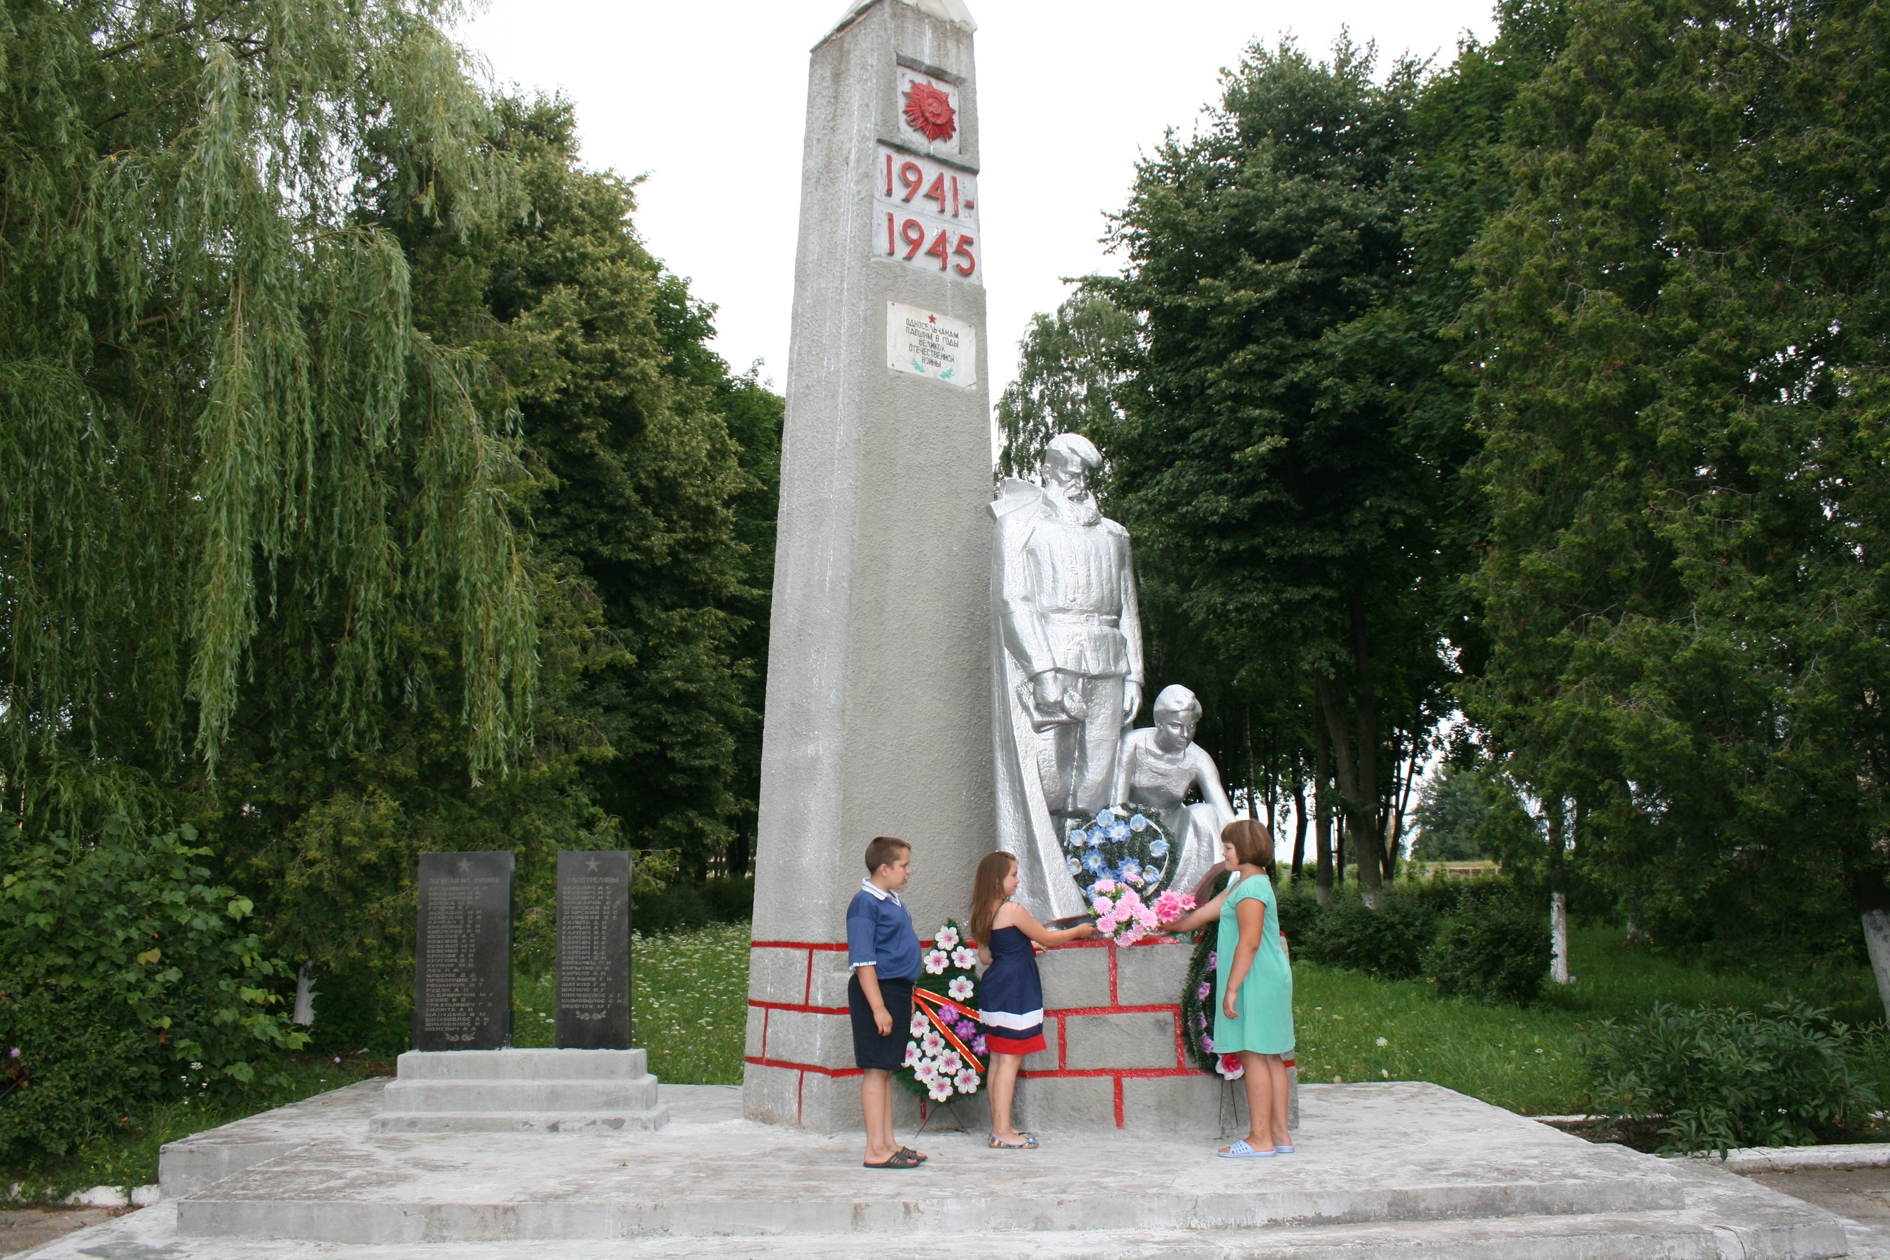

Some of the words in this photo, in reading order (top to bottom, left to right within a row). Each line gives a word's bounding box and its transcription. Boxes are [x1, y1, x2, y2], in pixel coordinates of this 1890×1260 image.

[887, 212, 975, 276] 1945
[906, 326, 932, 342] ПАВШИМ
[942, 336, 959, 348] ГОДЫ
[909, 343, 955, 363] ОТЕЧЕСТВЕННОЙ
[922, 356, 942, 368] ВОЙНЫ
